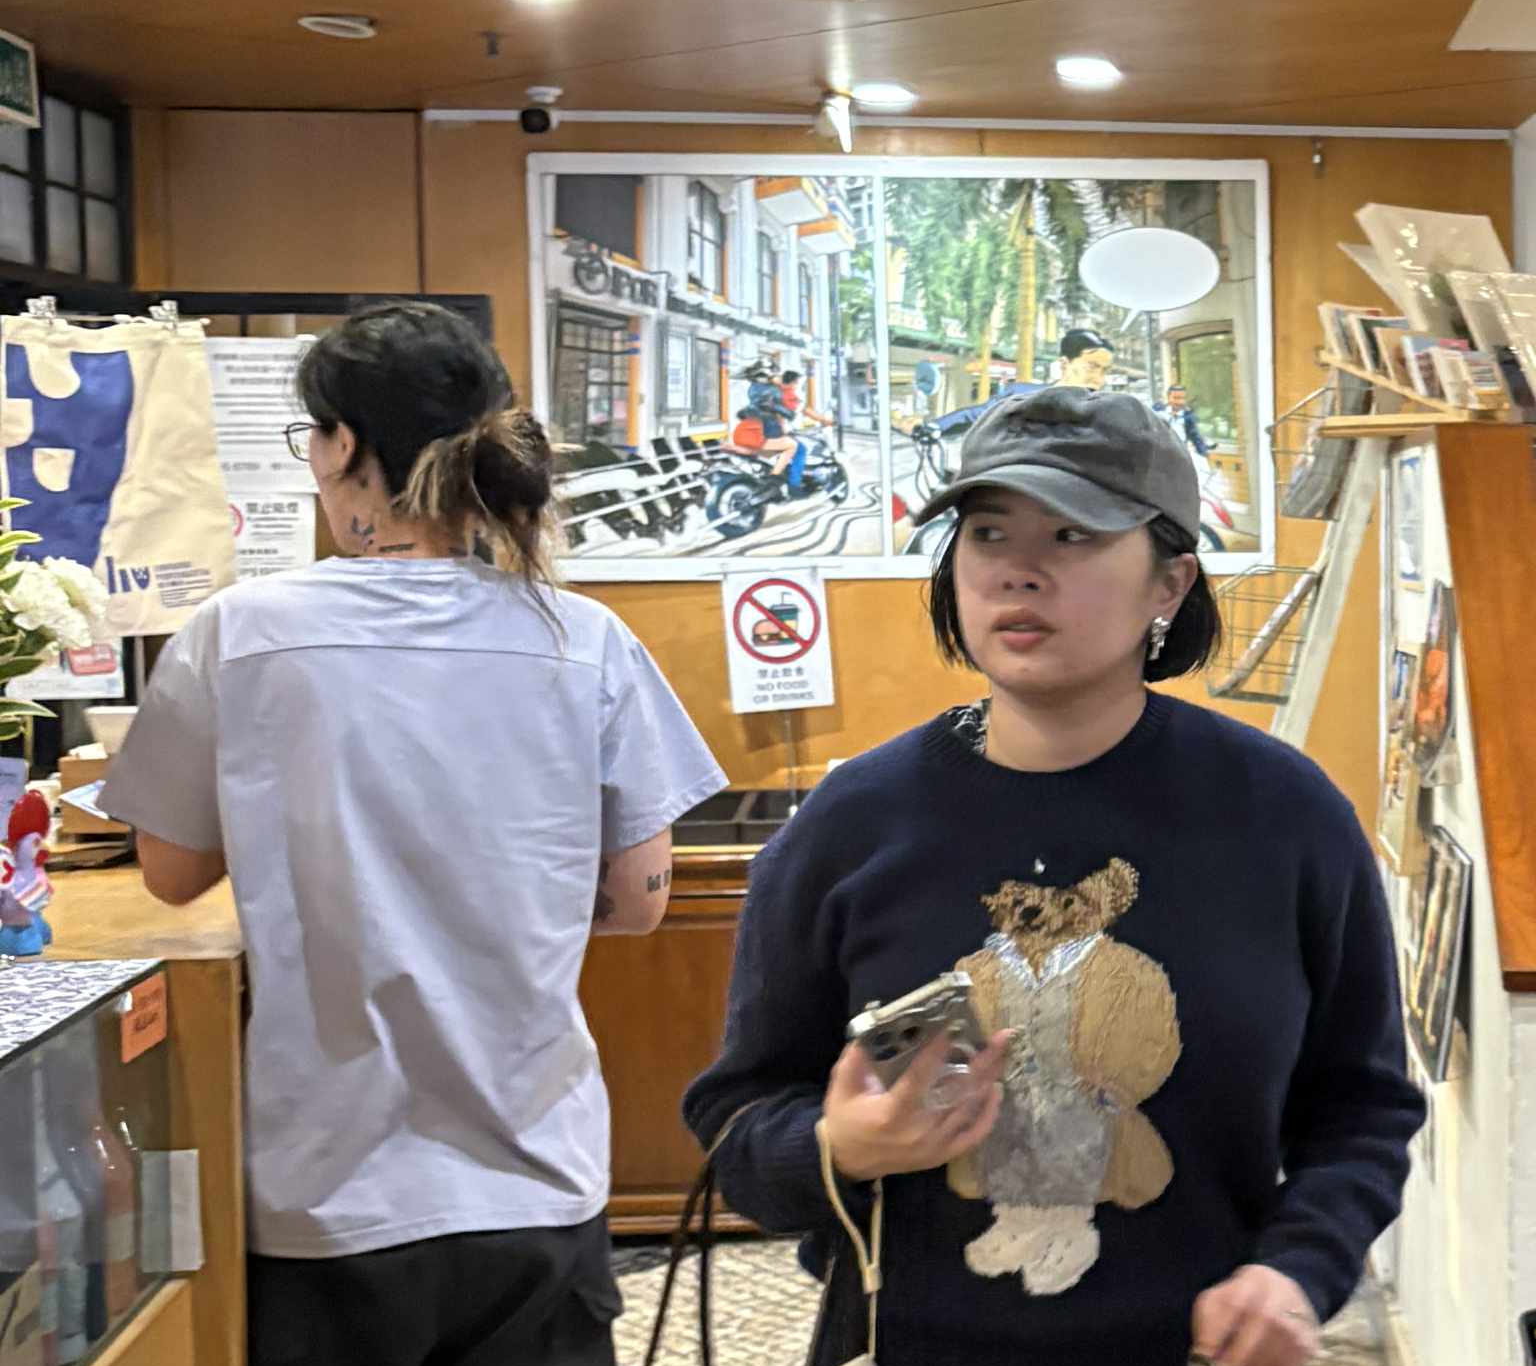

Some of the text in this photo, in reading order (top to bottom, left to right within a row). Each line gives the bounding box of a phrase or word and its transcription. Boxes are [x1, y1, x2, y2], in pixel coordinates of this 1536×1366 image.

[756, 680, 809, 692] NO FOOD
[753, 691, 815, 704] OR DRINKS
